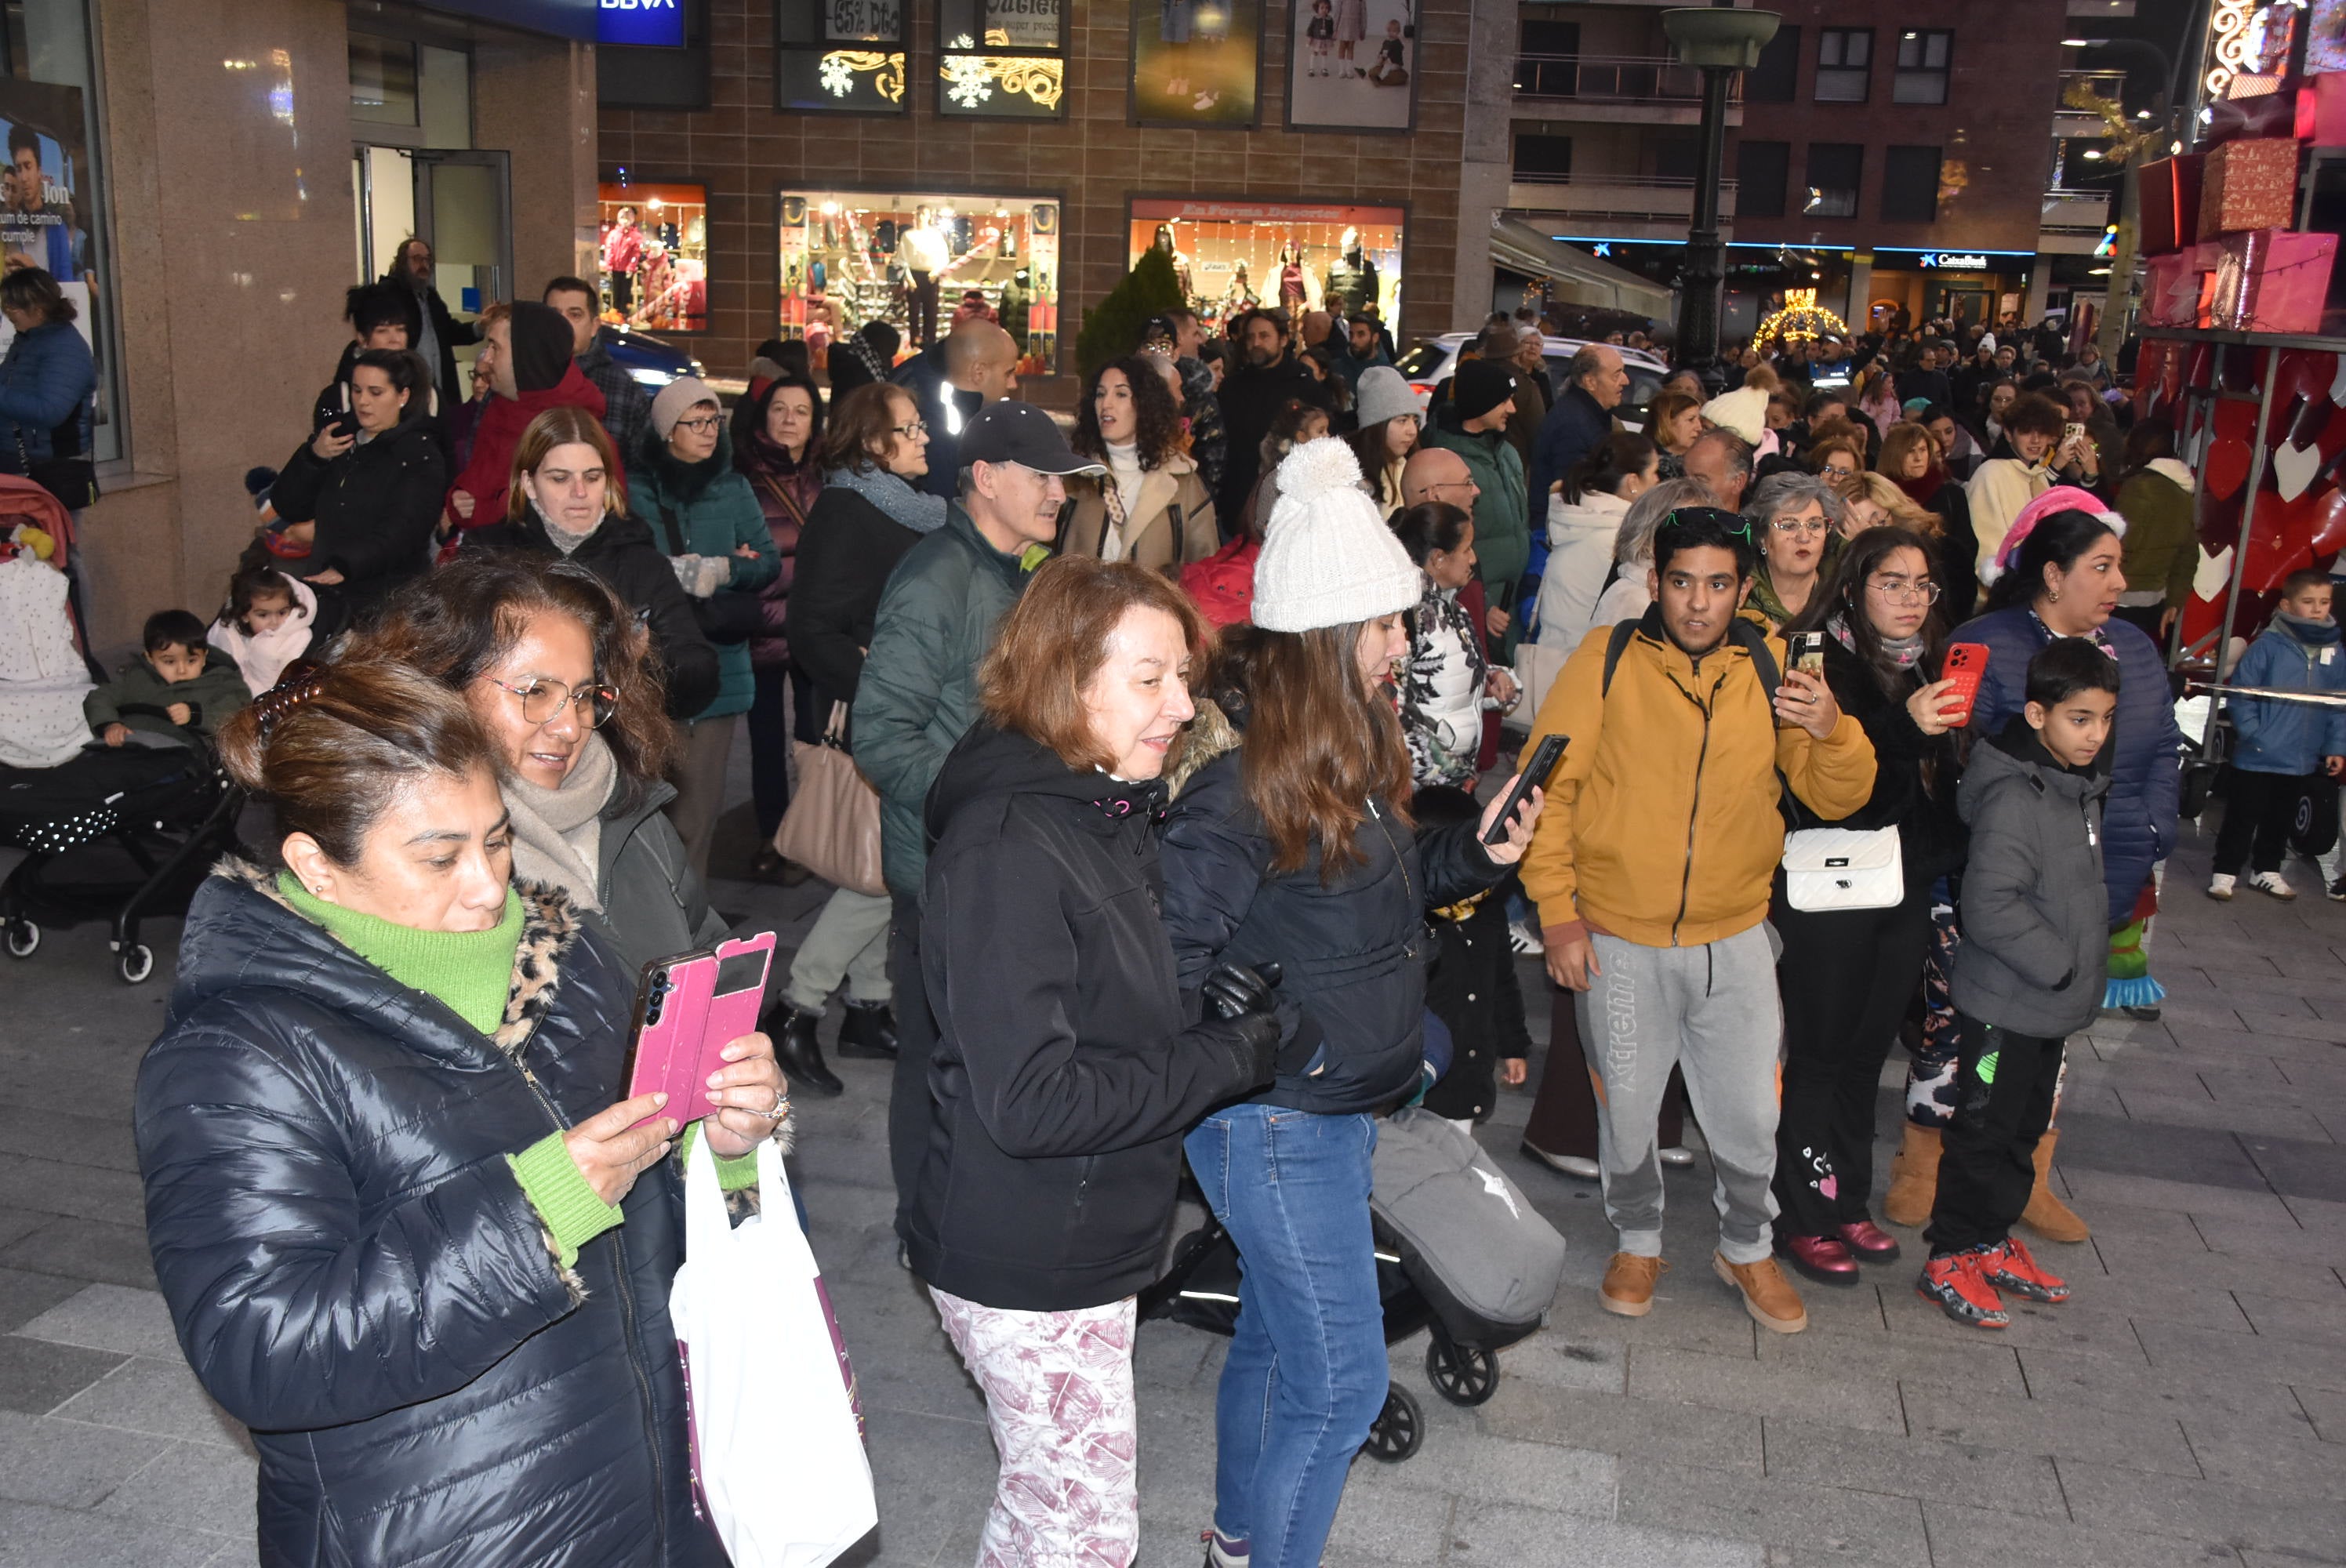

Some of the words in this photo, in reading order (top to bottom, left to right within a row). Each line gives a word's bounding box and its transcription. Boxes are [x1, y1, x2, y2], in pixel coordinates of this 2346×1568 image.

[42, 181, 70, 204] Jon
[17, 210, 29, 225] de
[30, 212, 63, 227] camino
[2, 229, 35, 246] cumple
[1938, 254, 1987, 267] CaixaBank
[1607, 949, 1637, 1092] Xtreme
